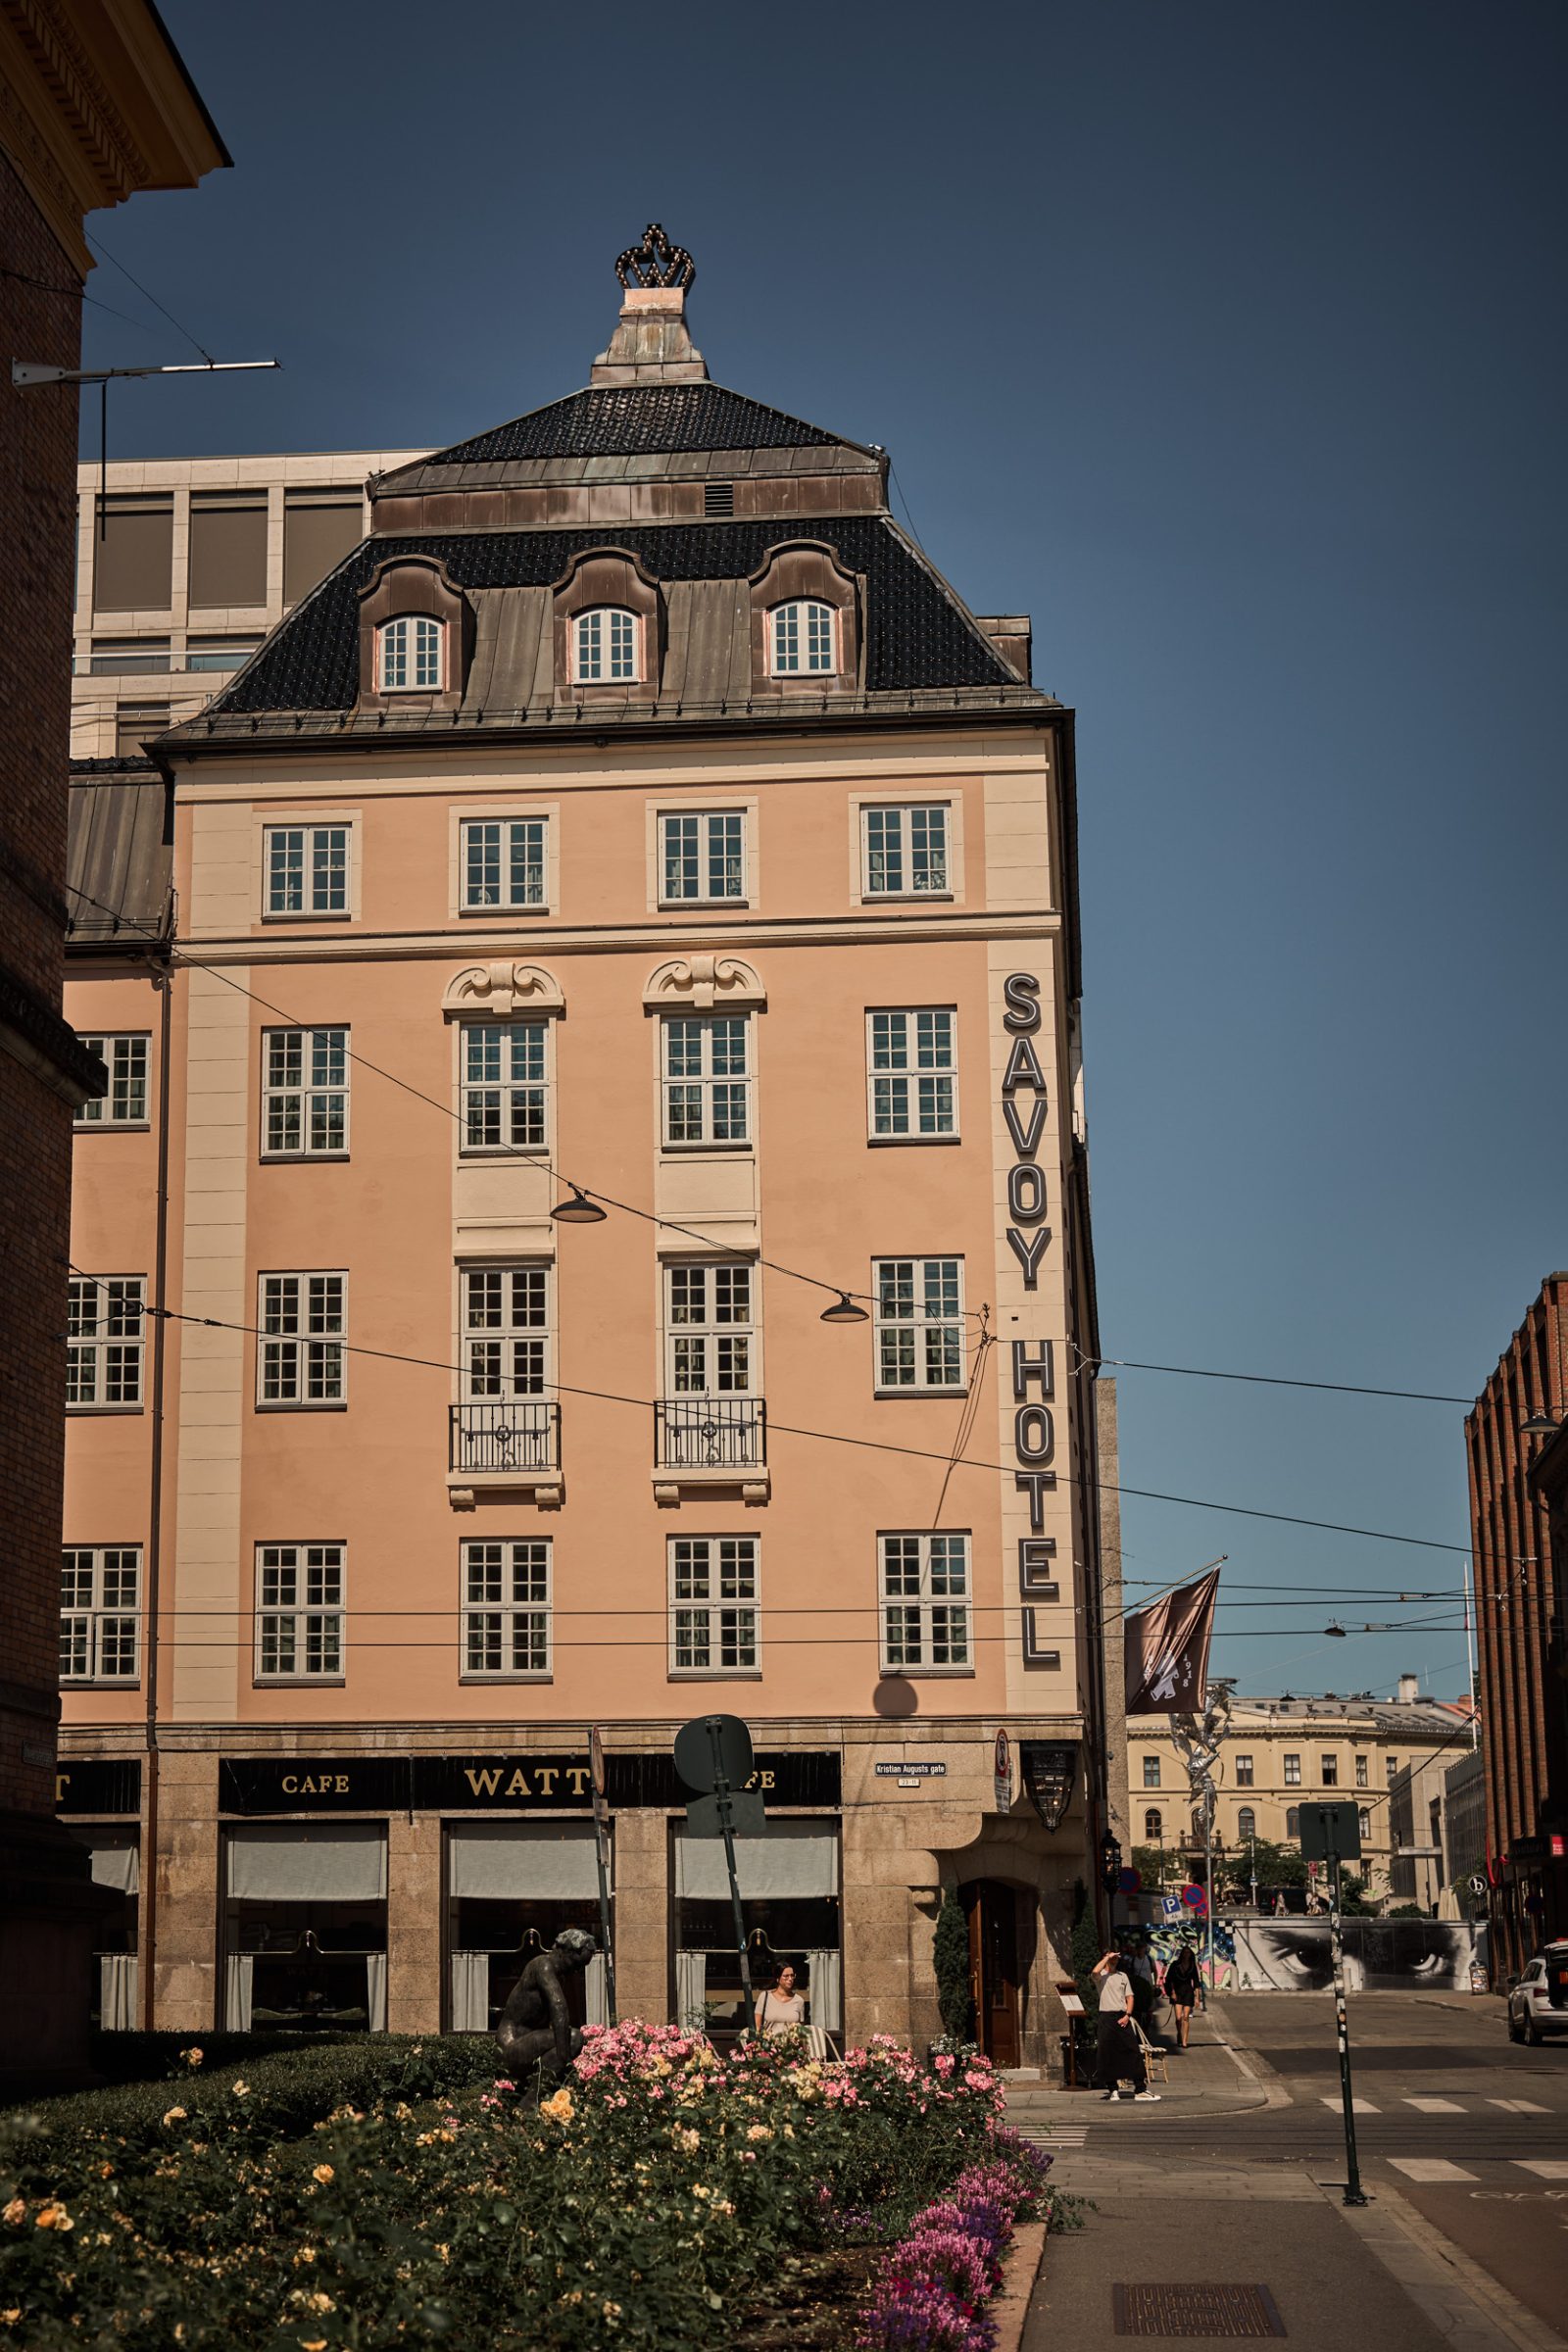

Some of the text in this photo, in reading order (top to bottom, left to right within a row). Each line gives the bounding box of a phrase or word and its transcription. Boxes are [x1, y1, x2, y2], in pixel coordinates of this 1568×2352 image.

[1002, 973, 1060, 1663] SAVOY HOTEL
[1183, 1653, 1193, 1688] 1918
[903, 1765, 928, 1775] Augusts
[930, 1765, 945, 1775] gate
[281, 1775, 350, 1793] CAFE
[464, 1768, 591, 1796] WATT
[740, 1771, 775, 1788] FE
[1165, 1898, 1176, 1912] P
